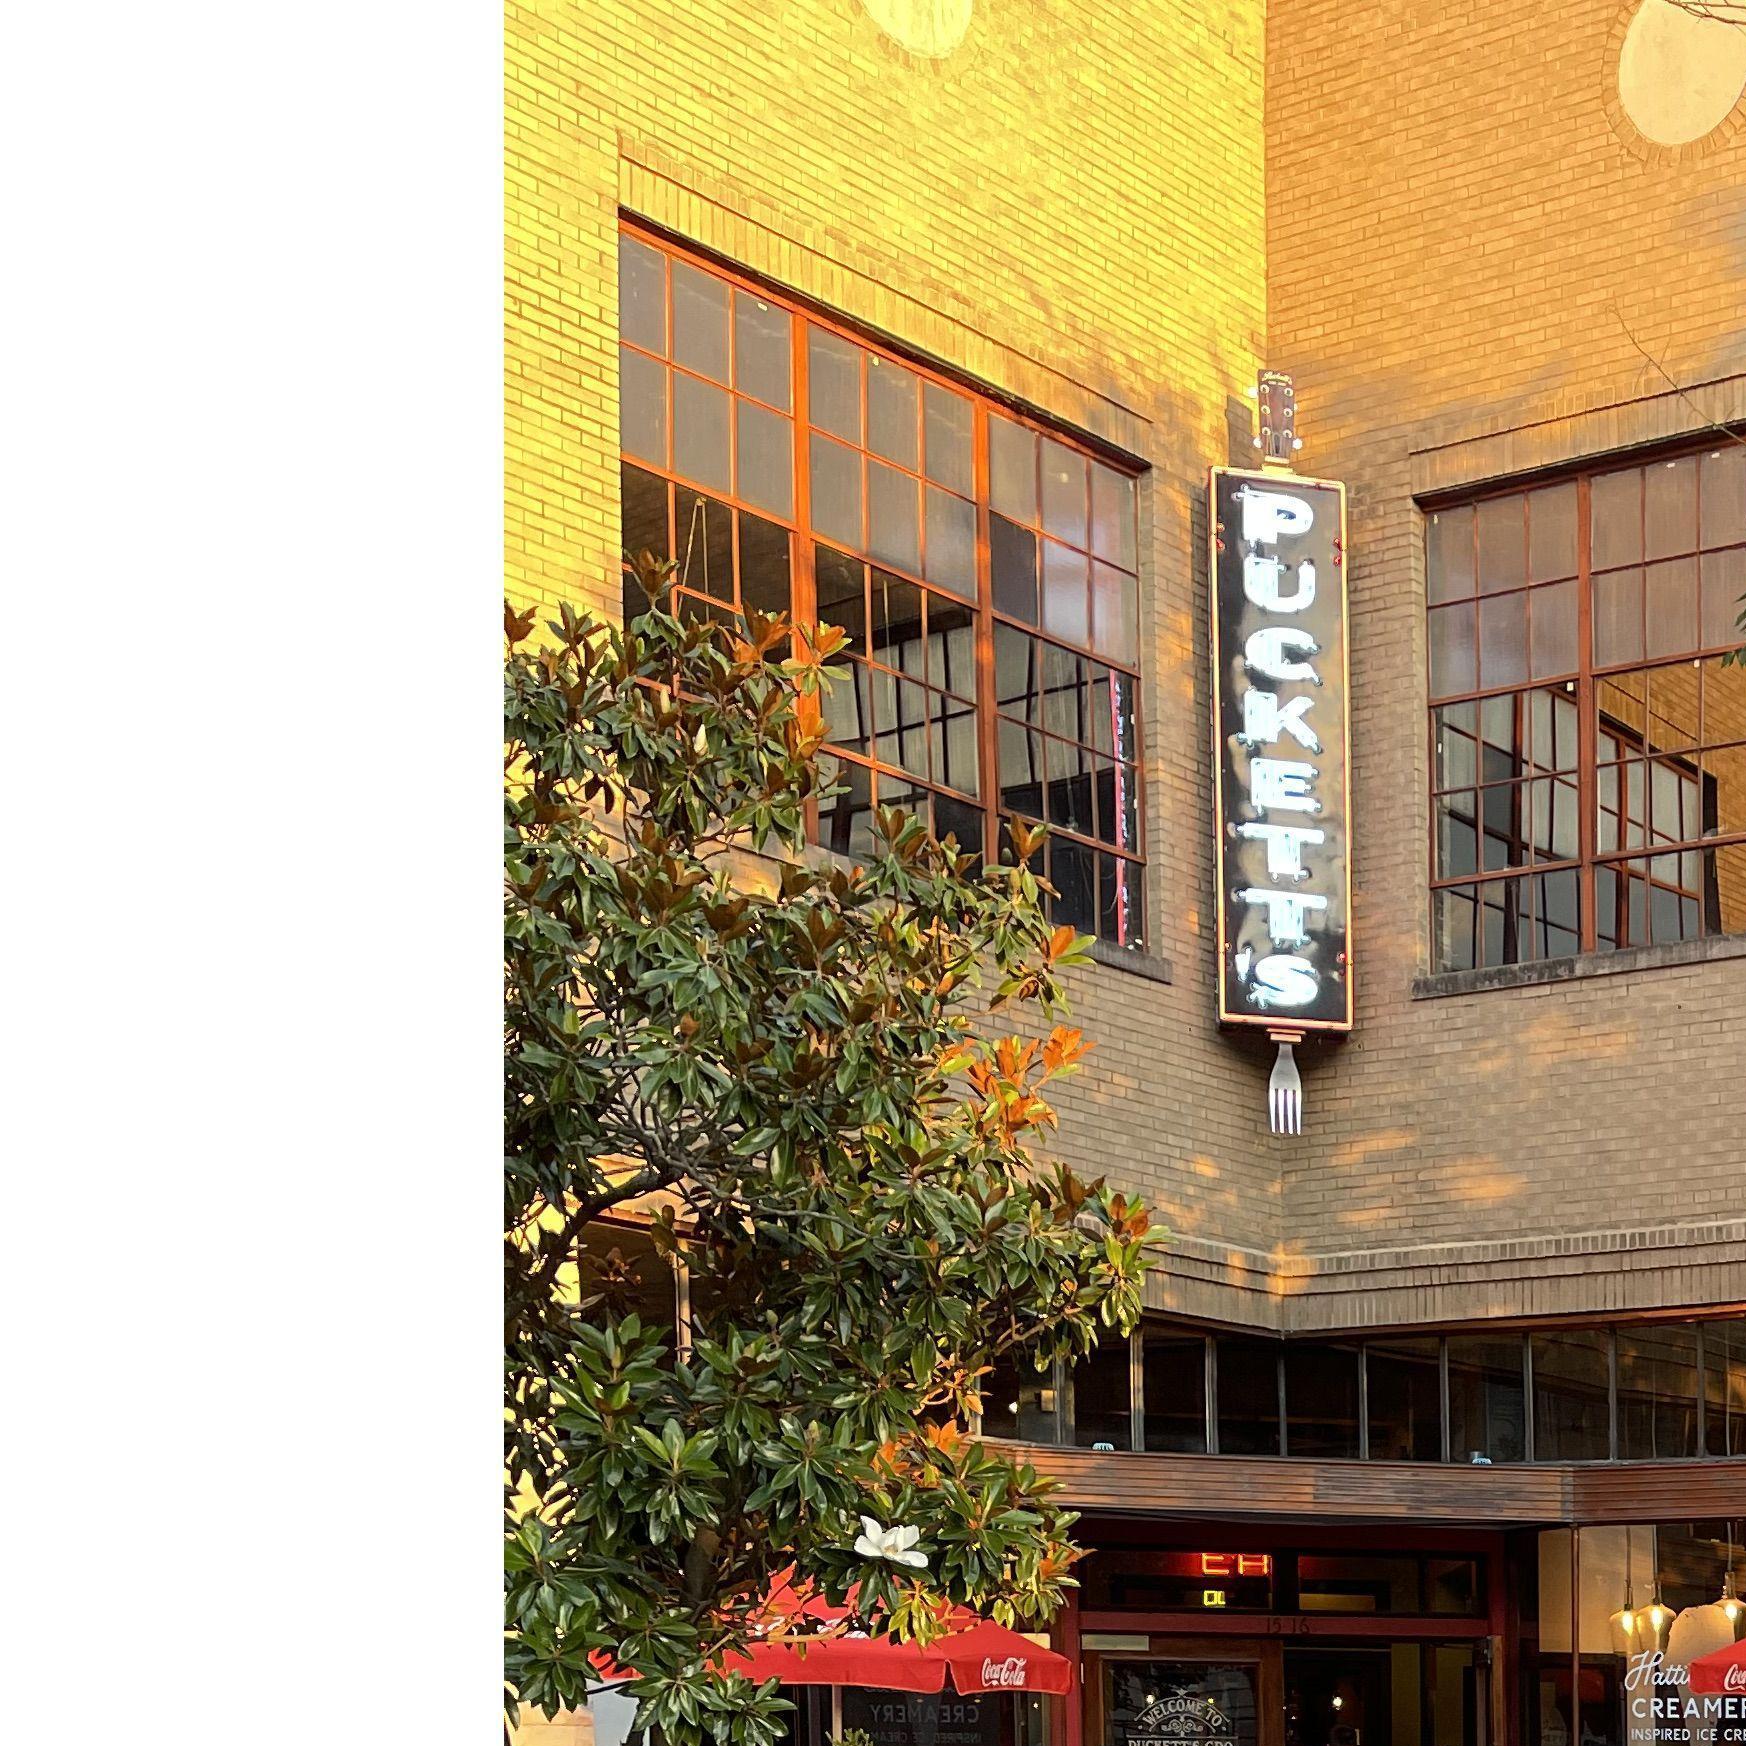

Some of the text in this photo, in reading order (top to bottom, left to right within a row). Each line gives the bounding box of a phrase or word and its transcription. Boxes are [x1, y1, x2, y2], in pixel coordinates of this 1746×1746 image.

[1233, 485, 1327, 1008] PUCKETT'S
[981, 1656, 1027, 1687] Coca-Cola
[1624, 1650, 1691, 1691] Hatti
[1142, 1699, 1223, 1727] WELCOME TO
[1631, 1728, 1691, 1741] INSPIRED
[1696, 1729, 1718, 1741] ICE
